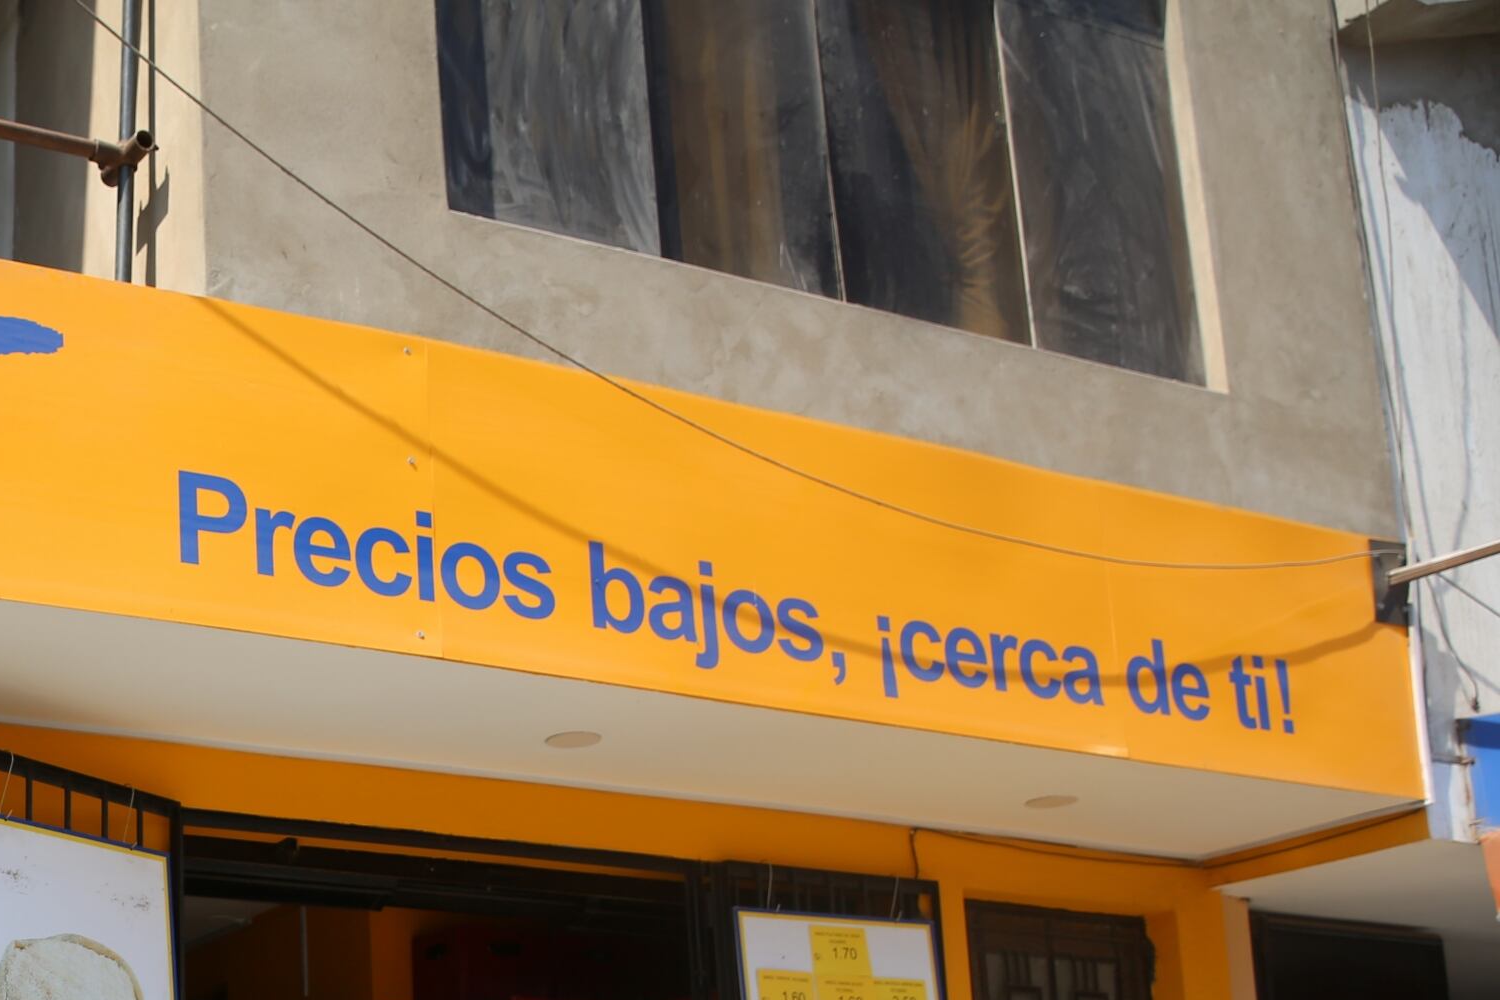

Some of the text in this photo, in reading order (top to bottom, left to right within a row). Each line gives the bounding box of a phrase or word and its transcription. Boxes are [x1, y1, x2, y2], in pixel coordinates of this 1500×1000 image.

[178, 470, 1295, 734] Precios bajos, ¡cerca de ti!
[832, 947, 858, 960] 1.70
